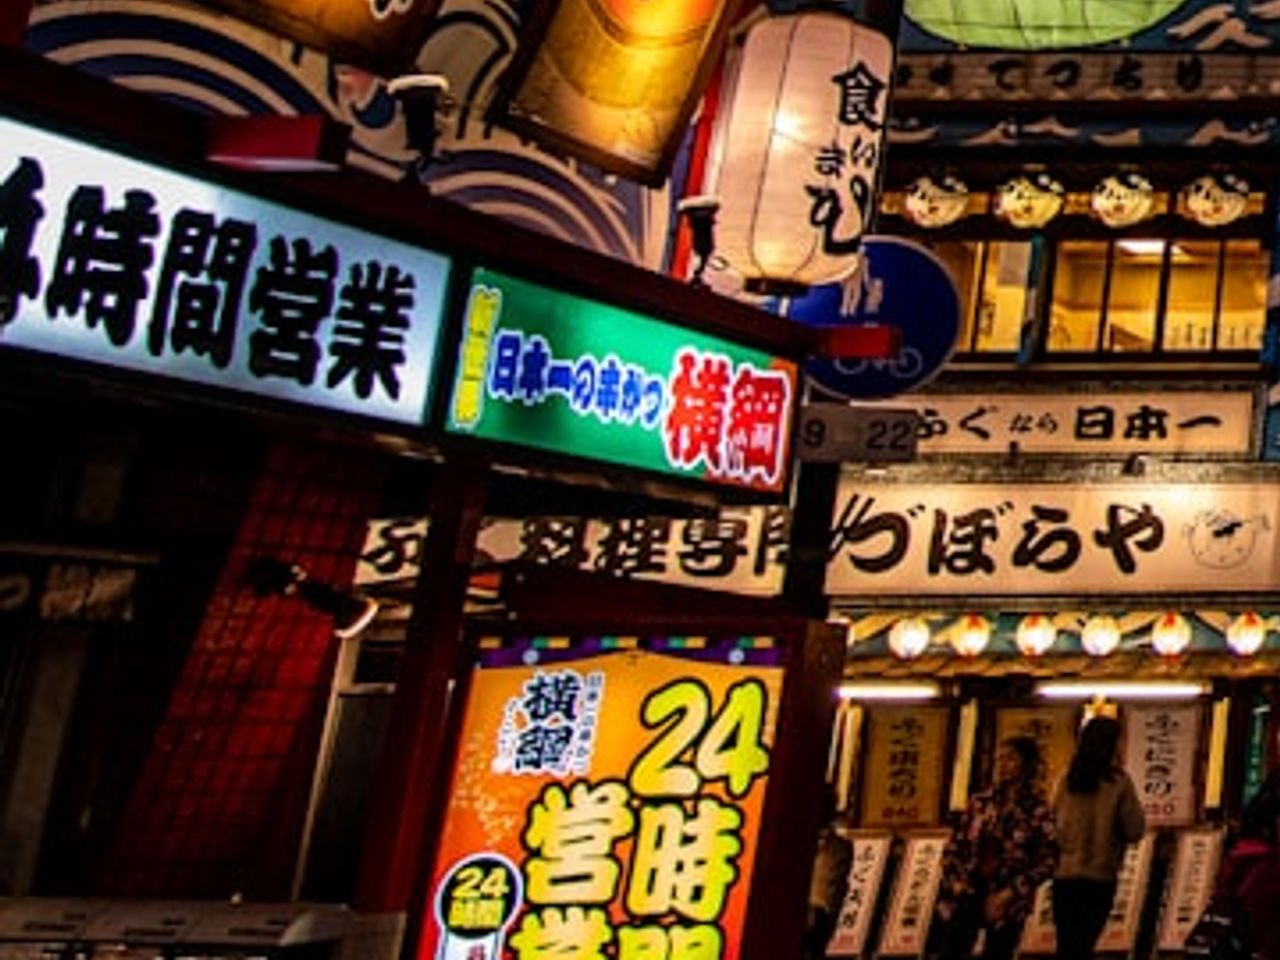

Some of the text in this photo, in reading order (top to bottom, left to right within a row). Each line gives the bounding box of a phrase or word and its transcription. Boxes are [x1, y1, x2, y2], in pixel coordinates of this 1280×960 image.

[491, 333, 664, 425] 日本一の串かつ
[667, 351, 789, 482] 横綱
[515, 672, 581, 771] 横綱
[450, 865, 512, 898] 24
